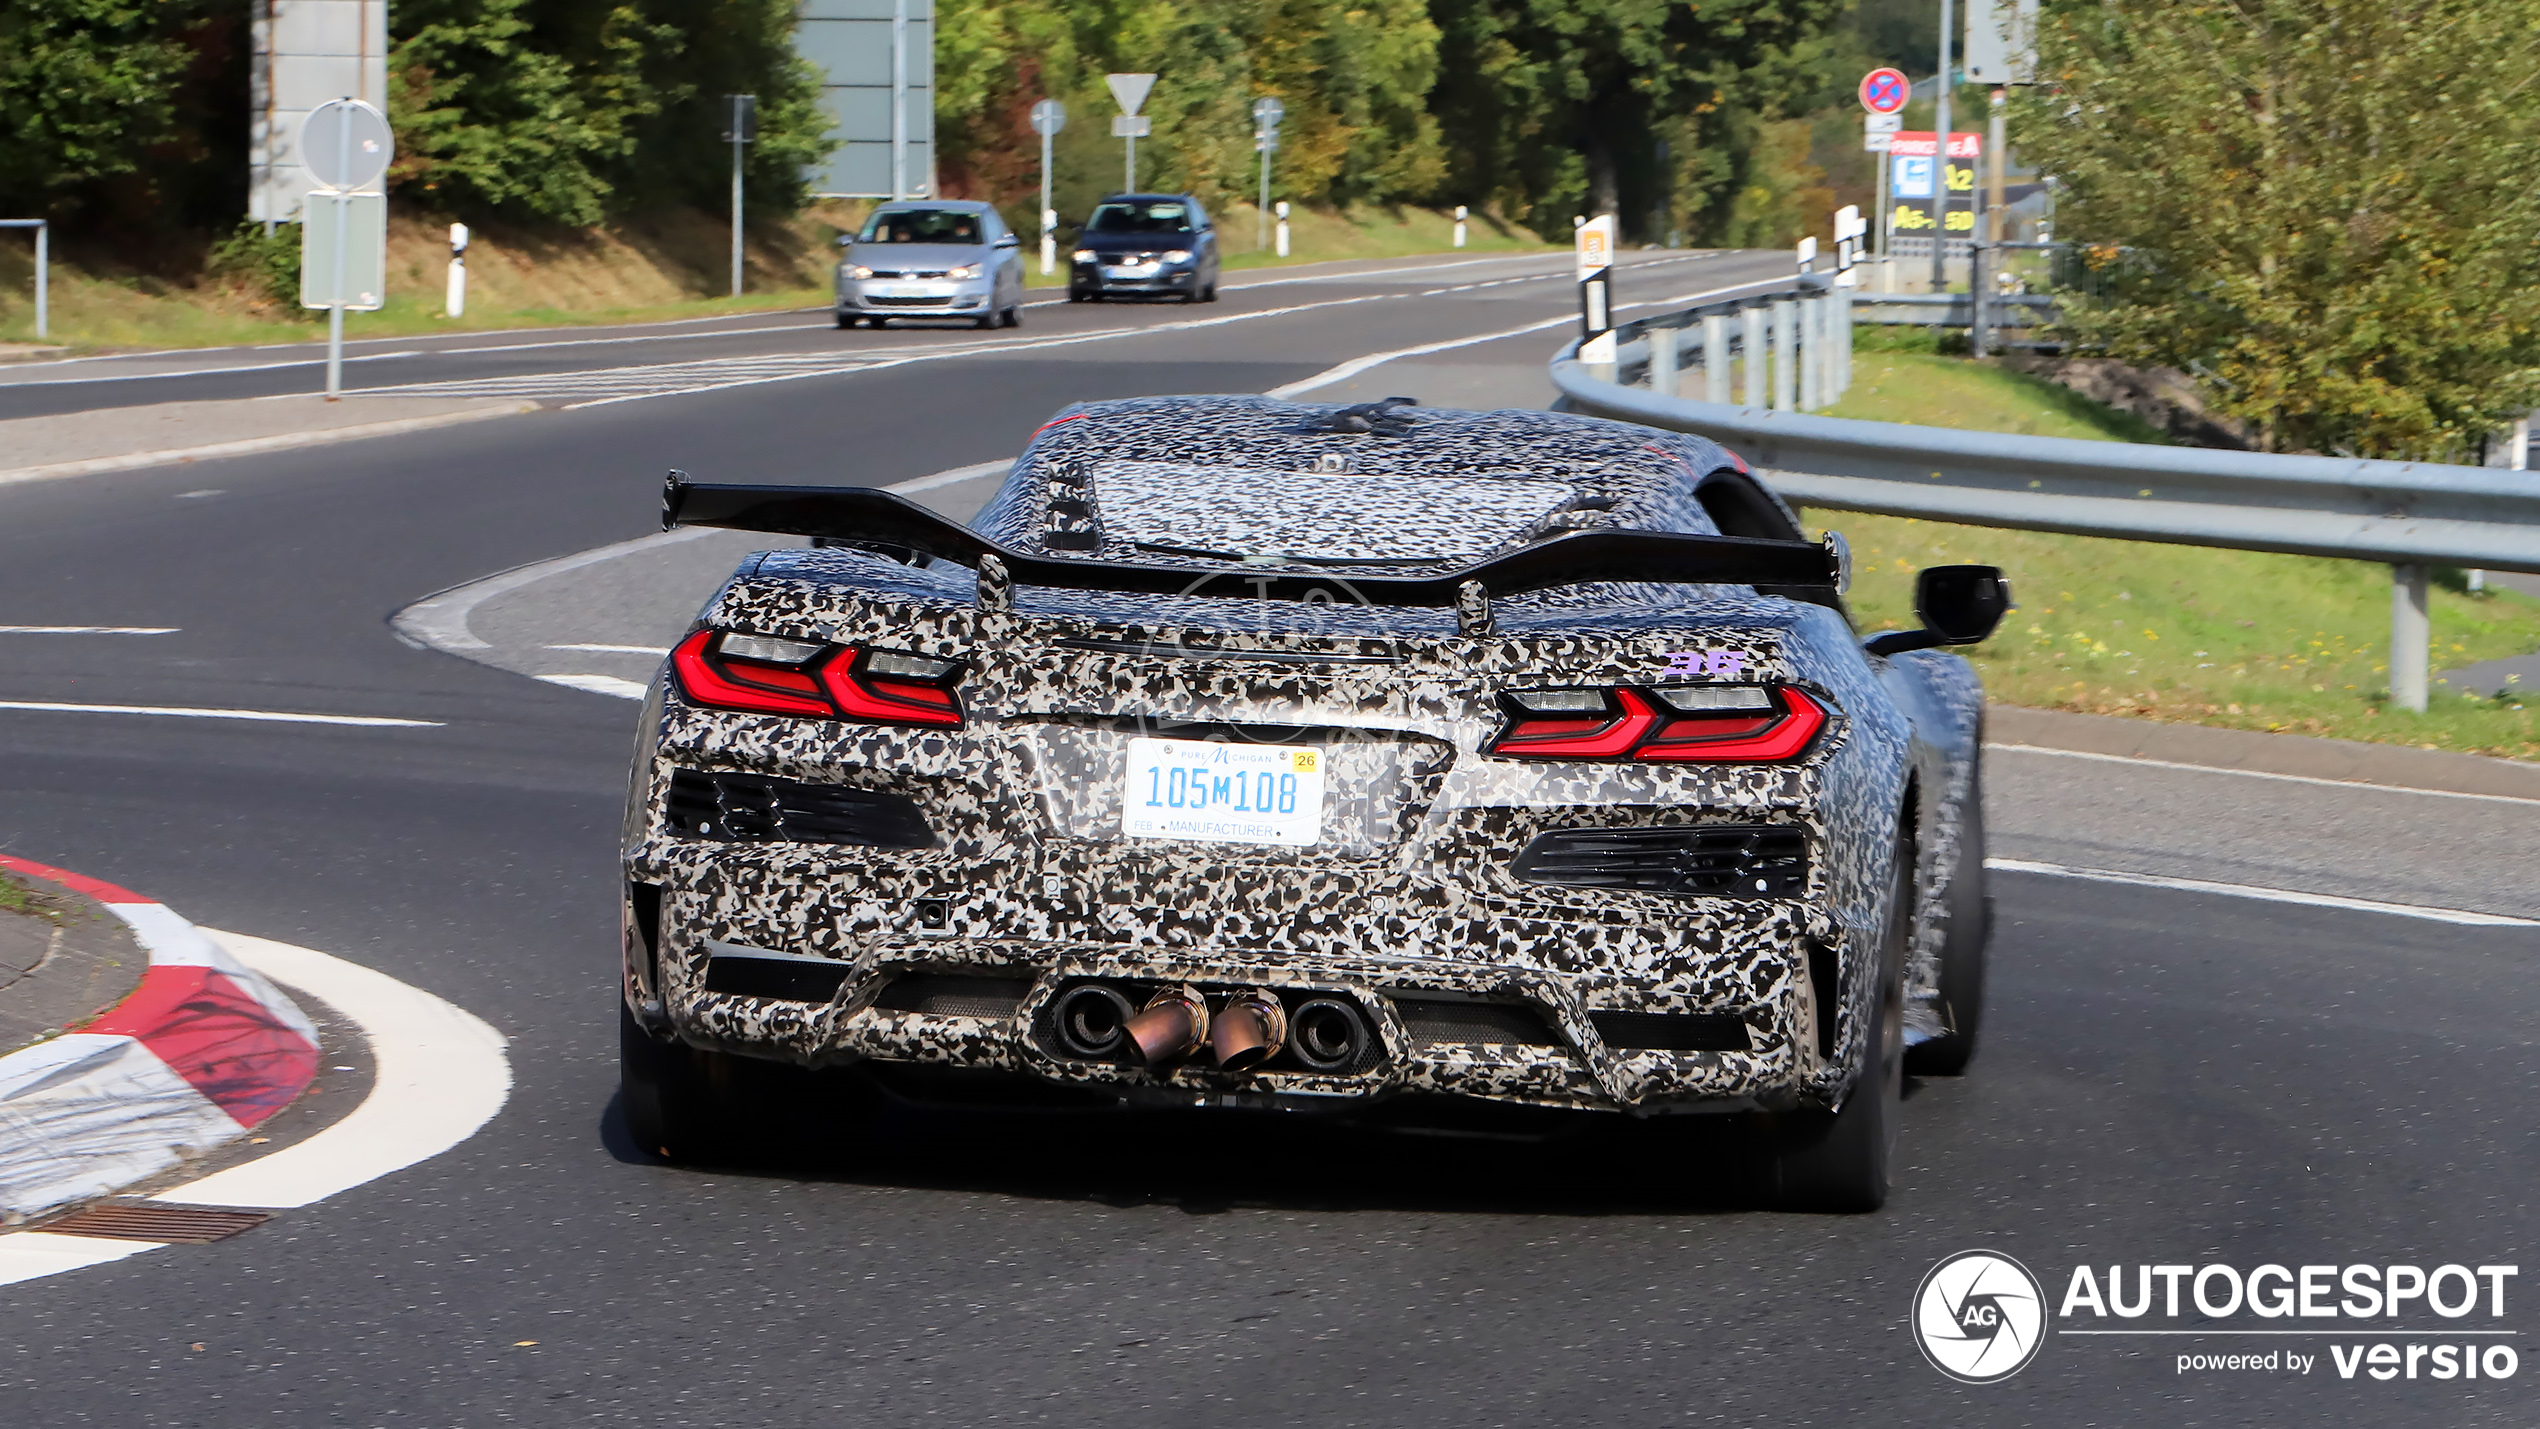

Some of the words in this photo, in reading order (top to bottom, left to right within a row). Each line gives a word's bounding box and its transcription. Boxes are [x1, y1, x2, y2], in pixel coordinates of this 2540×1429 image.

[1181, 751, 1207, 760] PURE
[1298, 755, 1315, 766] 26
[1146, 766, 1297, 814] 105M108
[1134, 820, 1153, 831] FEB
[1169, 820, 1273, 838] MANUFACTURER
